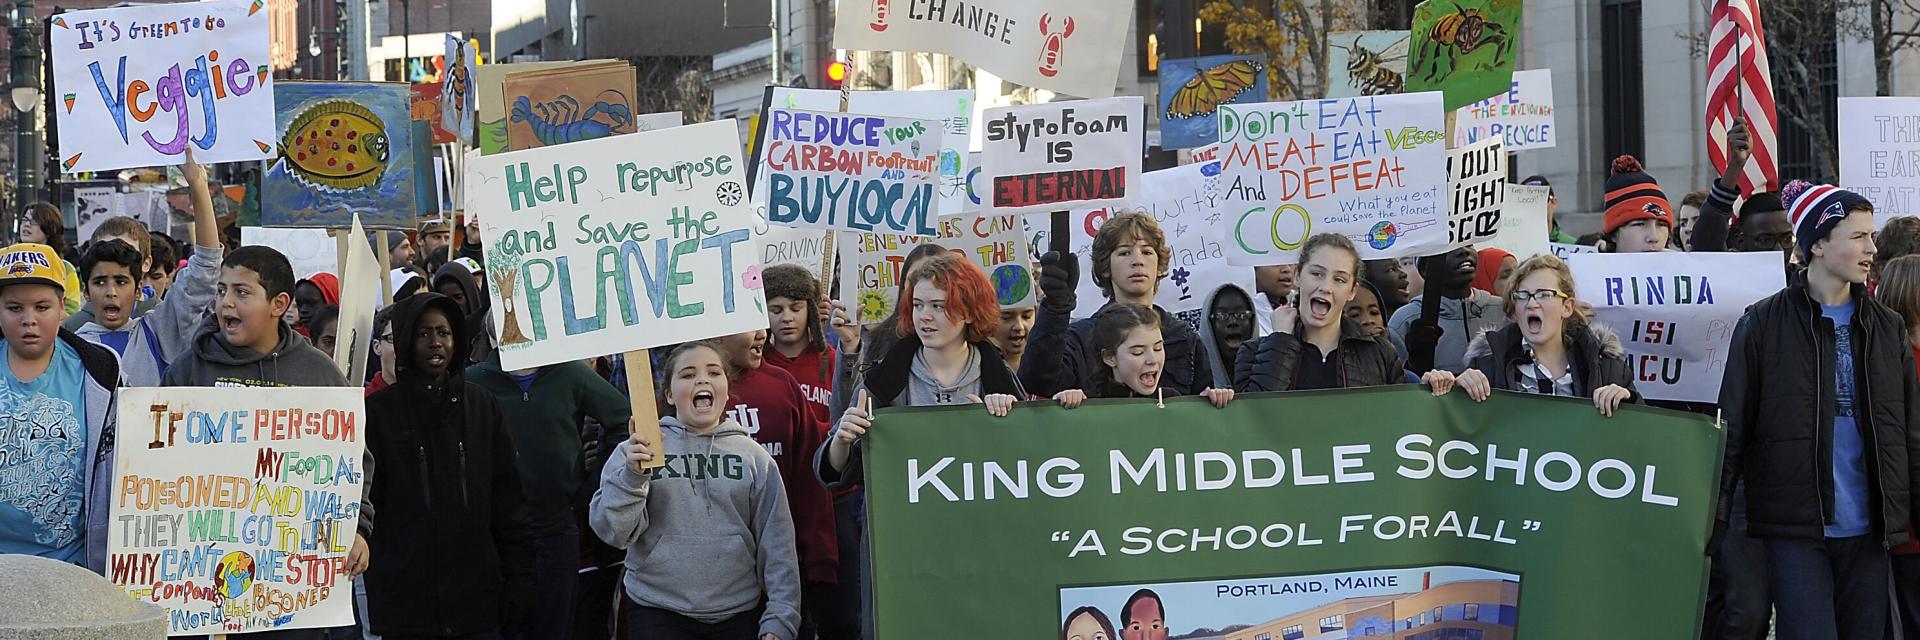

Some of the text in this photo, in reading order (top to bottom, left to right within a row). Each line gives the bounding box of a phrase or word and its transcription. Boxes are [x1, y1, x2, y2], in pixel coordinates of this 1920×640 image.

[908, 0, 1016, 45] CHANGE
[88, 50, 254, 155] Veggie
[1471, 104, 1496, 119] THE
[772, 110, 926, 147] REDUCE YOUR
[1456, 123, 1550, 148] AND RECYCLE
[767, 141, 863, 175] CARBON
[867, 150, 936, 173] FOOTPRINT
[1046, 141, 1073, 163] IS
[1460, 143, 1501, 179] OUT
[505, 162, 587, 212] Help
[616, 155, 732, 196] repurpose
[881, 168, 905, 180] AND
[994, 167, 1125, 206] ETERNAL
[1225, 175, 1266, 201] And
[769, 173, 849, 225] BUY
[847, 179, 937, 236] LOCAL
[1339, 184, 1437, 213] What you eat
[1377, 210, 1397, 219] the
[501, 222, 557, 256] and
[575, 214, 650, 244] Save
[666, 206, 720, 239] the
[973, 215, 1015, 238] CAN
[977, 241, 1015, 267] THE
[521, 228, 750, 341] PLANET
[1605, 275, 1714, 305] RINDA
[1631, 319, 1676, 345] ISI
[148, 404, 355, 449] IF ONE PERSON
[254, 448, 284, 482] MY
[650, 453, 743, 480] KING
[907, 433, 1679, 506] KING MIDDLE SCHOOL
[119, 474, 250, 511] POISONED
[250, 483, 302, 517] AND
[118, 514, 184, 547] THEY
[187, 509, 239, 543] WILL
[241, 515, 273, 546] GO
[301, 519, 347, 553] JAIL
[1119, 522, 1323, 555] SCHOOL
[111, 553, 161, 585] WHY
[255, 549, 284, 582] WE
[285, 553, 348, 588] STOP
[1216, 575, 1398, 598] PORTLAND, MAINE
